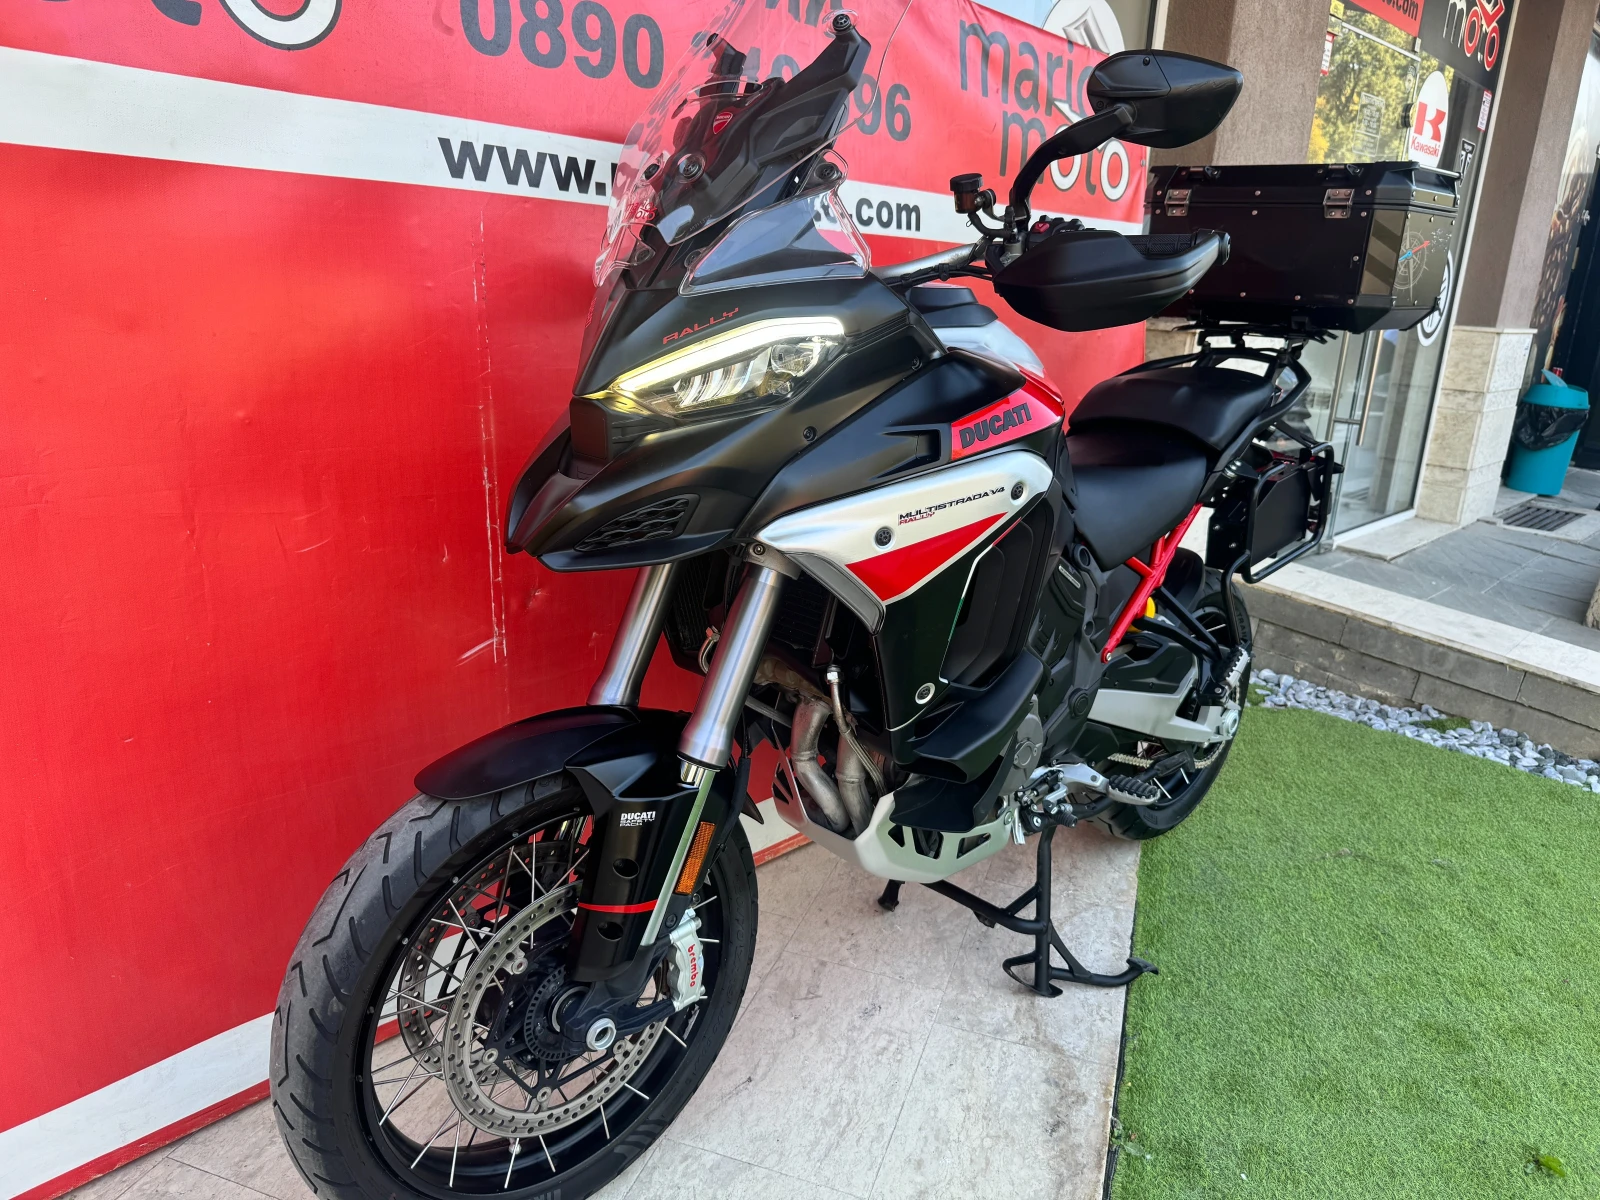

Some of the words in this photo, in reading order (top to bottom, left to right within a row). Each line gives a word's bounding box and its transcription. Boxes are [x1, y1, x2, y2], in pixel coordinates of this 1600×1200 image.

[460, 0, 664, 88] 0890
[437, 136, 619, 197] www.
[1411, 136, 1440, 158] Kawasaki
[662, 307, 739, 345] RALLY
[959, 402, 1032, 449] DUCATI
[899, 491, 990, 519] MULTISTRADA
[991, 486, 1005, 495] V4
[620, 811, 656, 820] DUCATI
[687, 943, 699, 988] brembo
